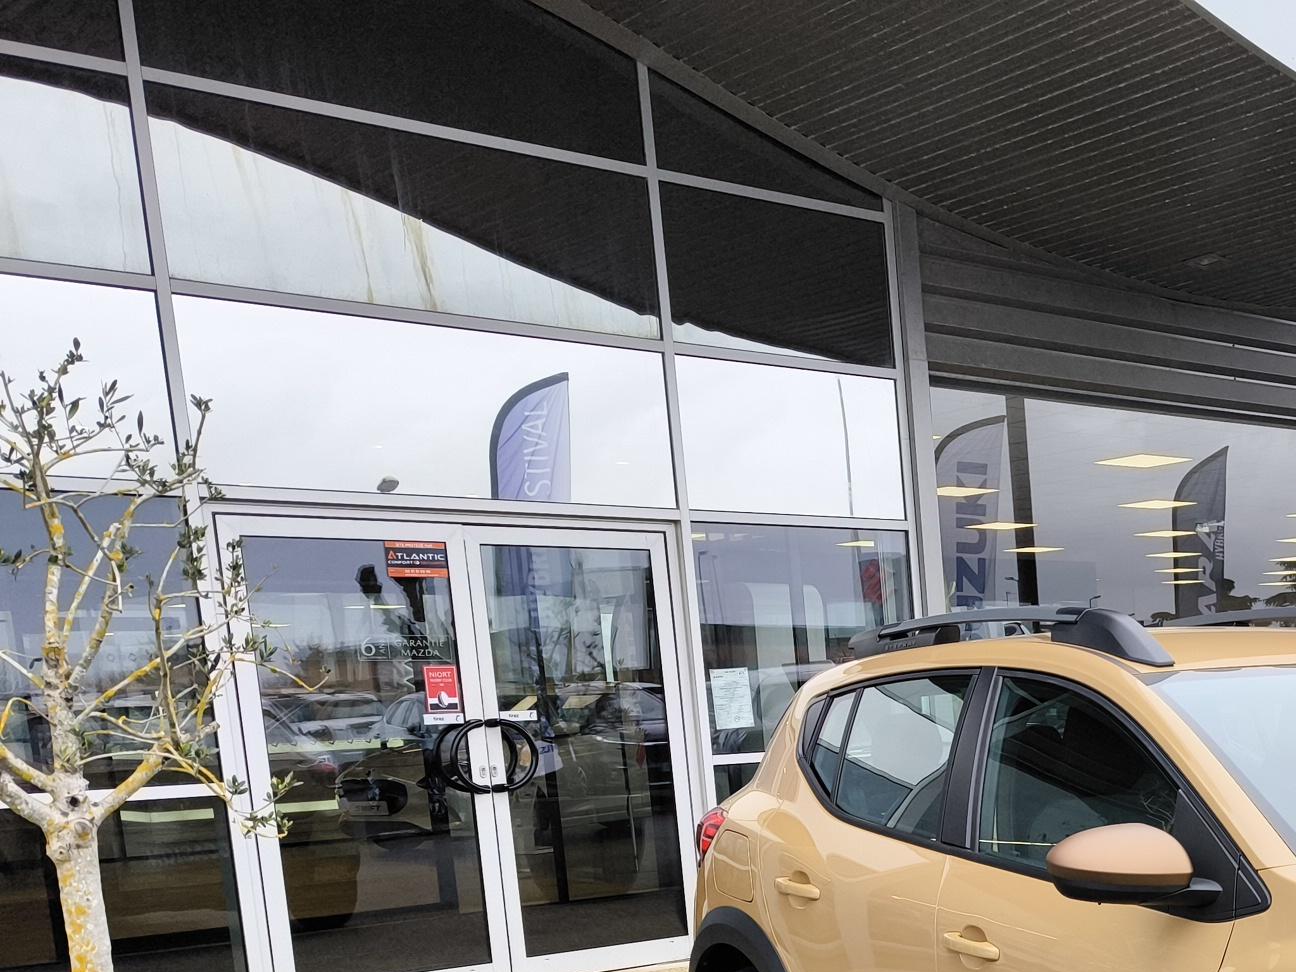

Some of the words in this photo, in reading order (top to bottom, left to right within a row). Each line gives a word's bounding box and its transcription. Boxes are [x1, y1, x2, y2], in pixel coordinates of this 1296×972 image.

[387, 550, 445, 560] ATLANTIC
[361, 636, 376, 656] 6
[401, 649, 440, 657] MAZDA
